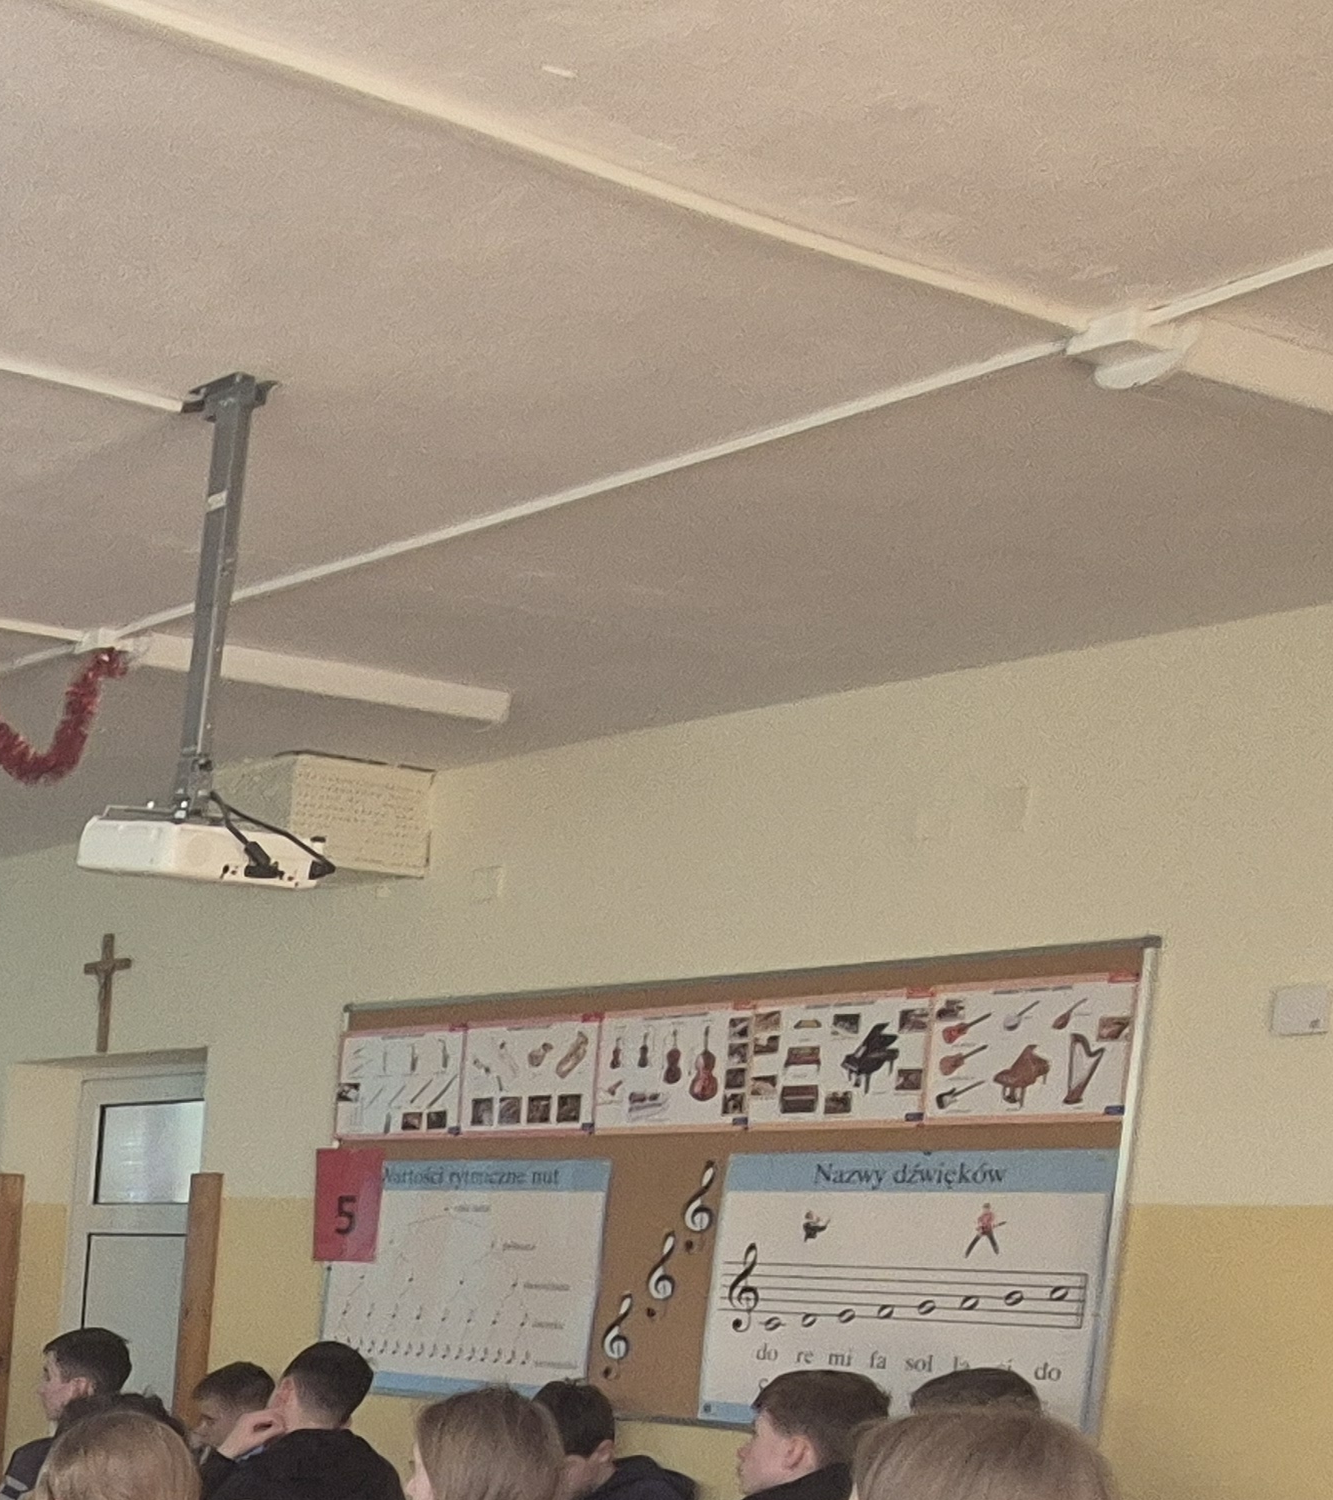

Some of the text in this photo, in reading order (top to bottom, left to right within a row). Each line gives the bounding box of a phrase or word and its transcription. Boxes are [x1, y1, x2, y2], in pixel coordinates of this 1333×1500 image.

[532, 1168, 560, 1184] nut
[814, 1161, 1008, 1191] Nazwy dźwięków
[335, 1195, 357, 1235] 5
[756, 1343, 779, 1361] do
[796, 1350, 814, 1364] re
[828, 1347, 853, 1367] mi
[869, 1350, 888, 1370] fa
[904, 1354, 933, 1373] sol
[1034, 1362, 1062, 1382] do
